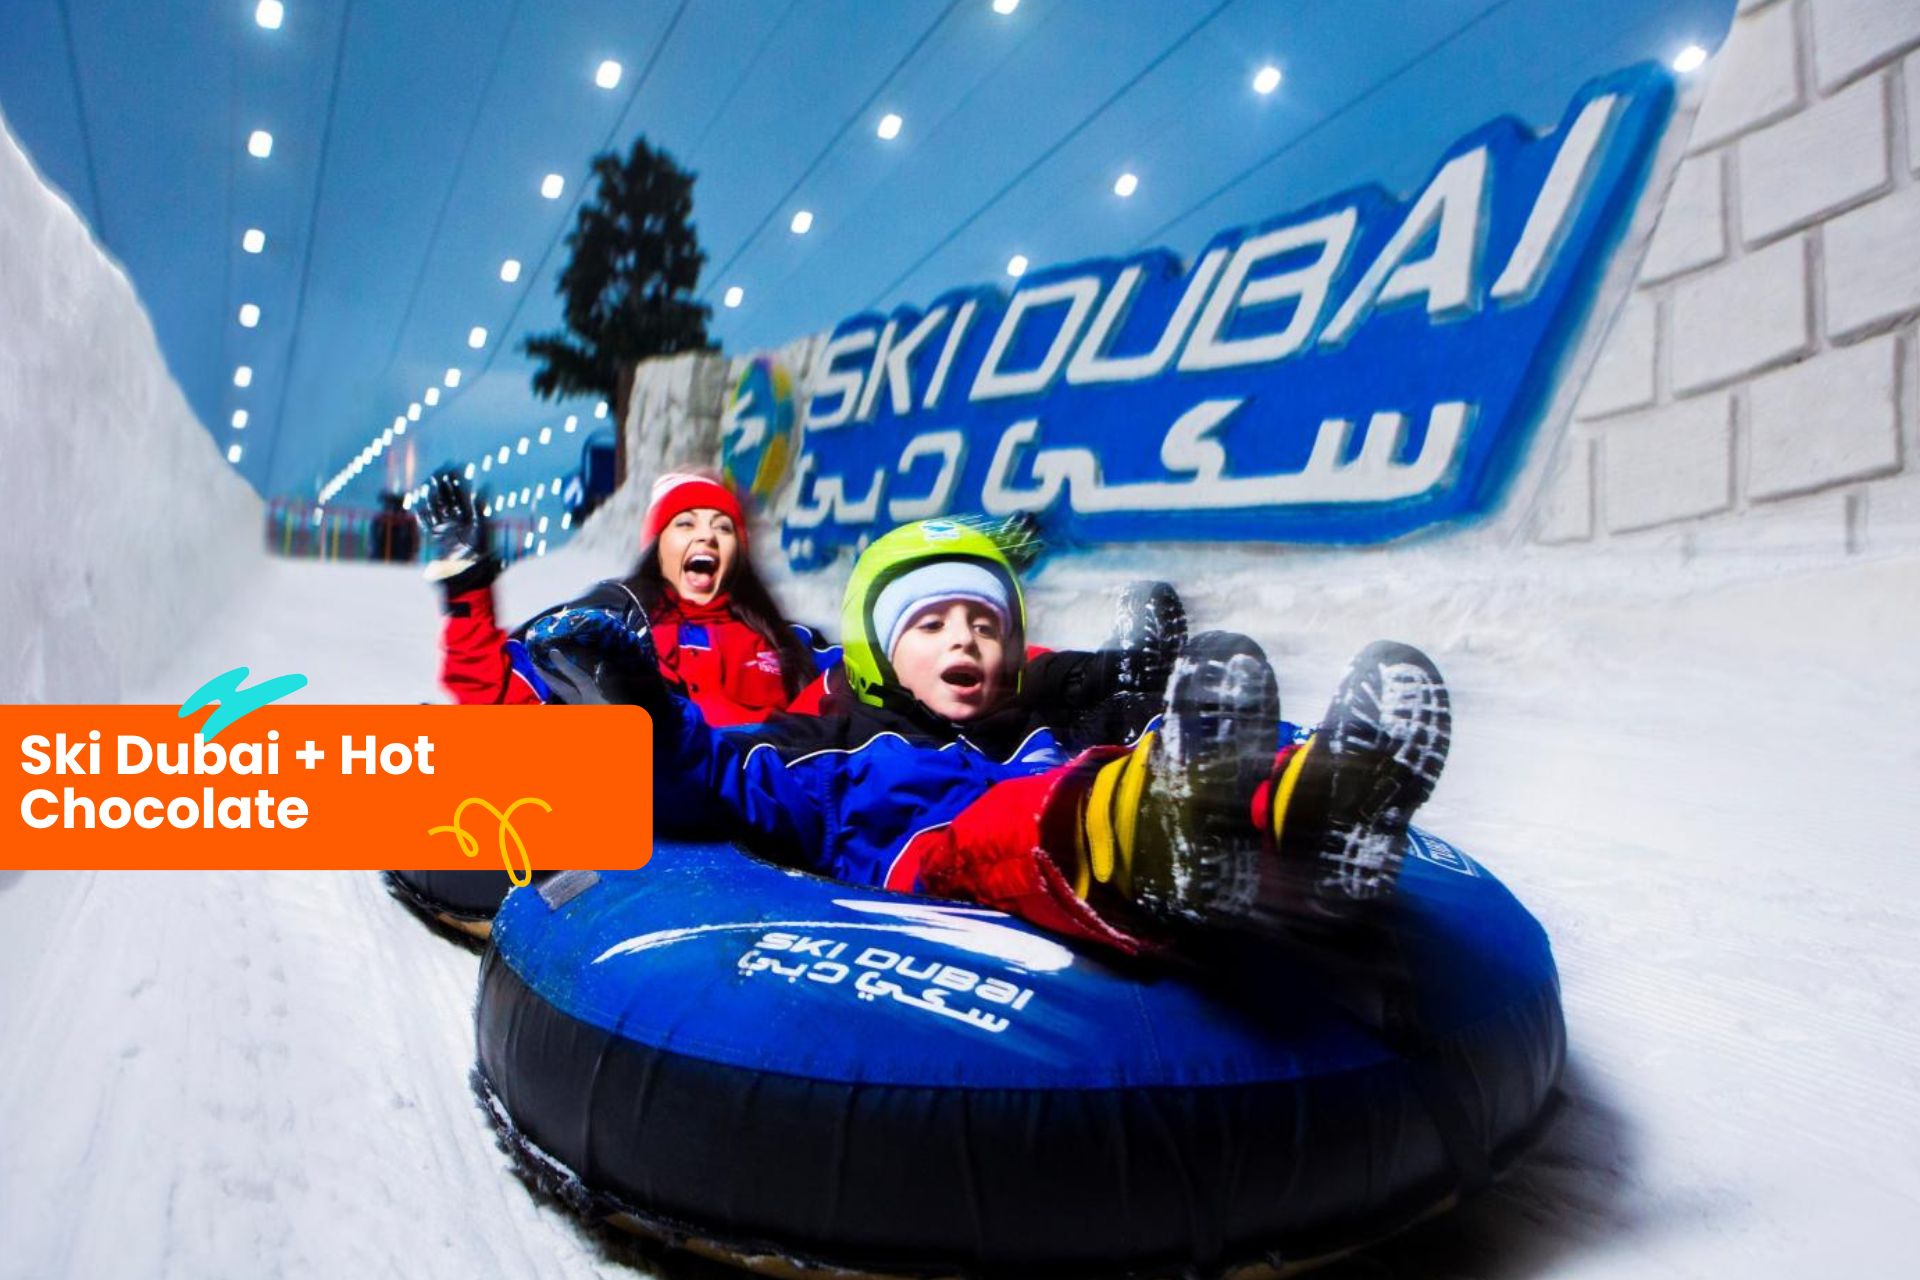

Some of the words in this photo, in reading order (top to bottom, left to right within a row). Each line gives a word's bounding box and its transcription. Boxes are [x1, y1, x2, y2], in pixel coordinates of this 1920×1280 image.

[805, 299, 977, 433] SKI
[968, 94, 1618, 403] DUBAI
[754, 932, 849, 960] SKI
[855, 971, 1010, 1033] سكي
